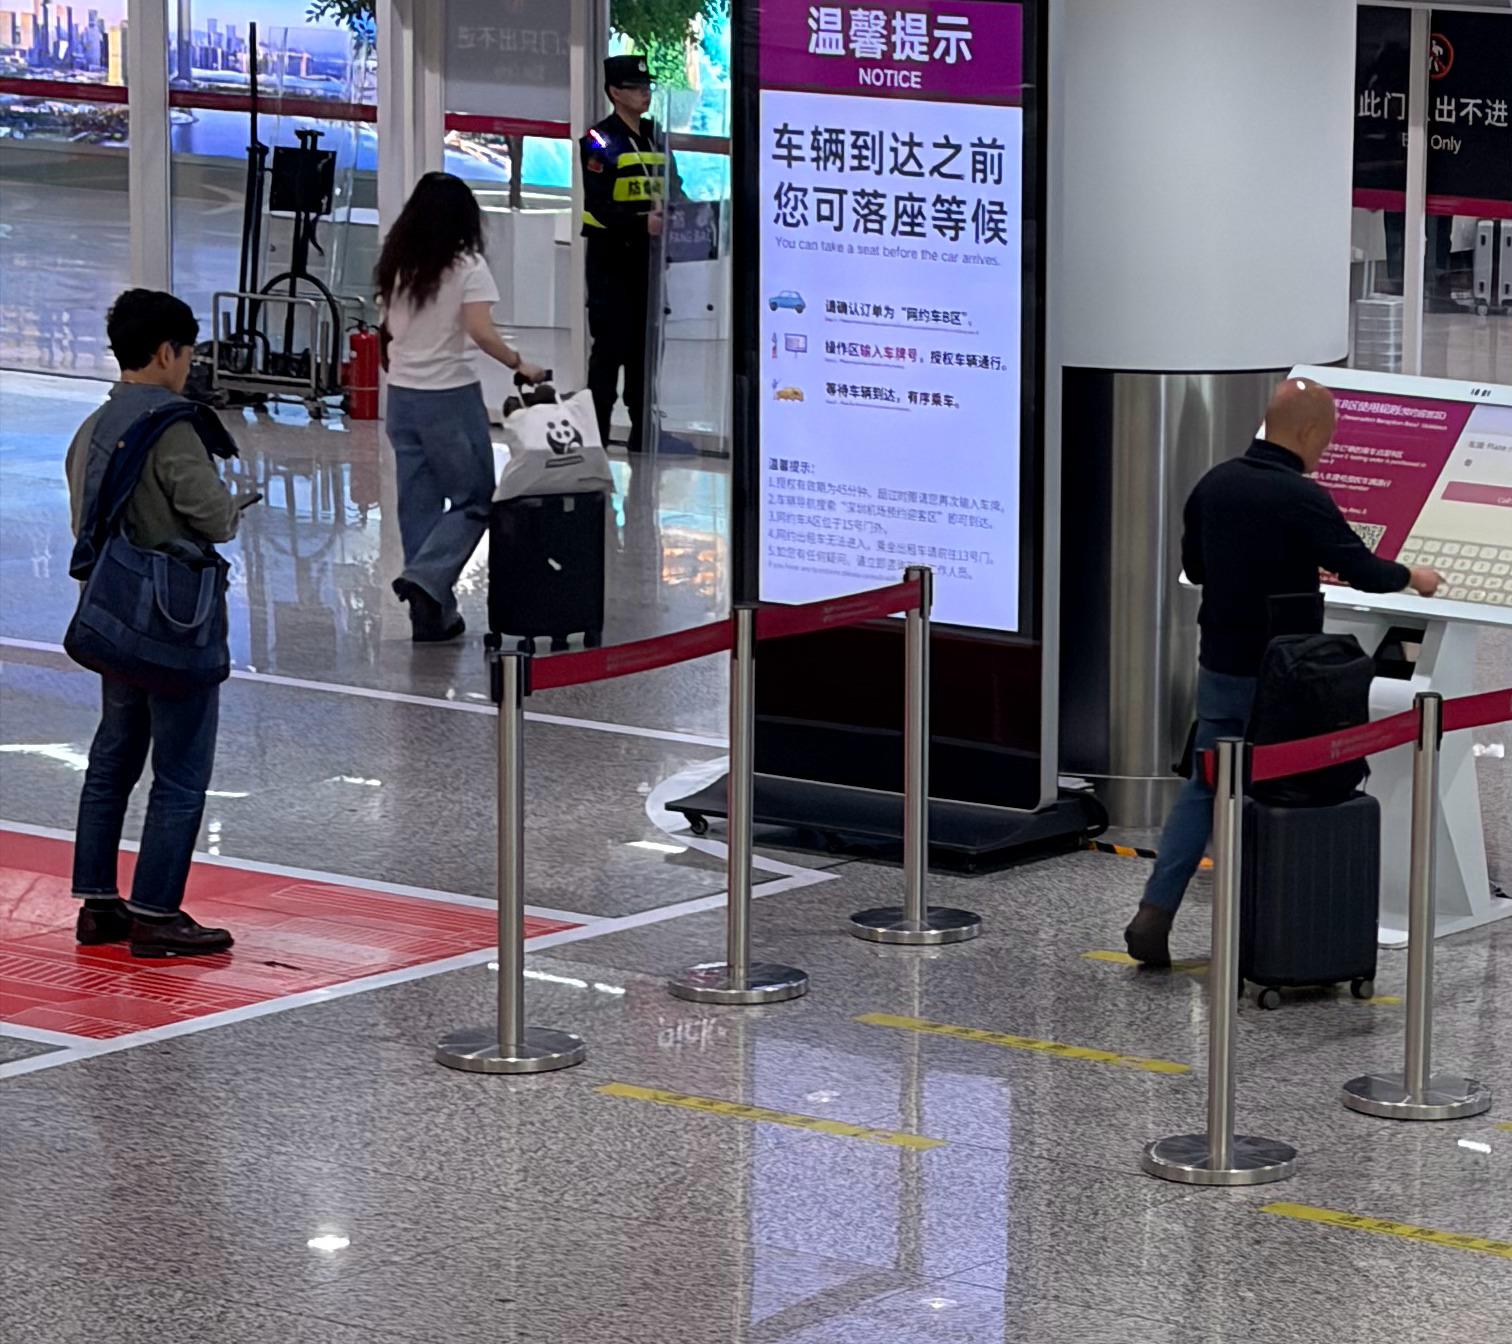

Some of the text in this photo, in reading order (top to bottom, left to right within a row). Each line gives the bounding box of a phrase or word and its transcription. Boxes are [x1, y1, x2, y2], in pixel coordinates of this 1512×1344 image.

[808, 6, 973, 64] 温馨提示
[858, 67, 922, 89] NOTICE
[1357, 89, 1509, 128] 此门出不进
[771, 122, 1006, 186] 车辆到达之前
[1430, 134, 1462, 155] Only
[772, 181, 1008, 246] 您可落座等候
[775, 235, 796, 250] You
[798, 239, 819, 251] can
[820, 238, 846, 254] take
[857, 244, 881, 257] seat
[882, 245, 919, 261] before
[920, 248, 939, 262] the
[940, 251, 959, 264] car
